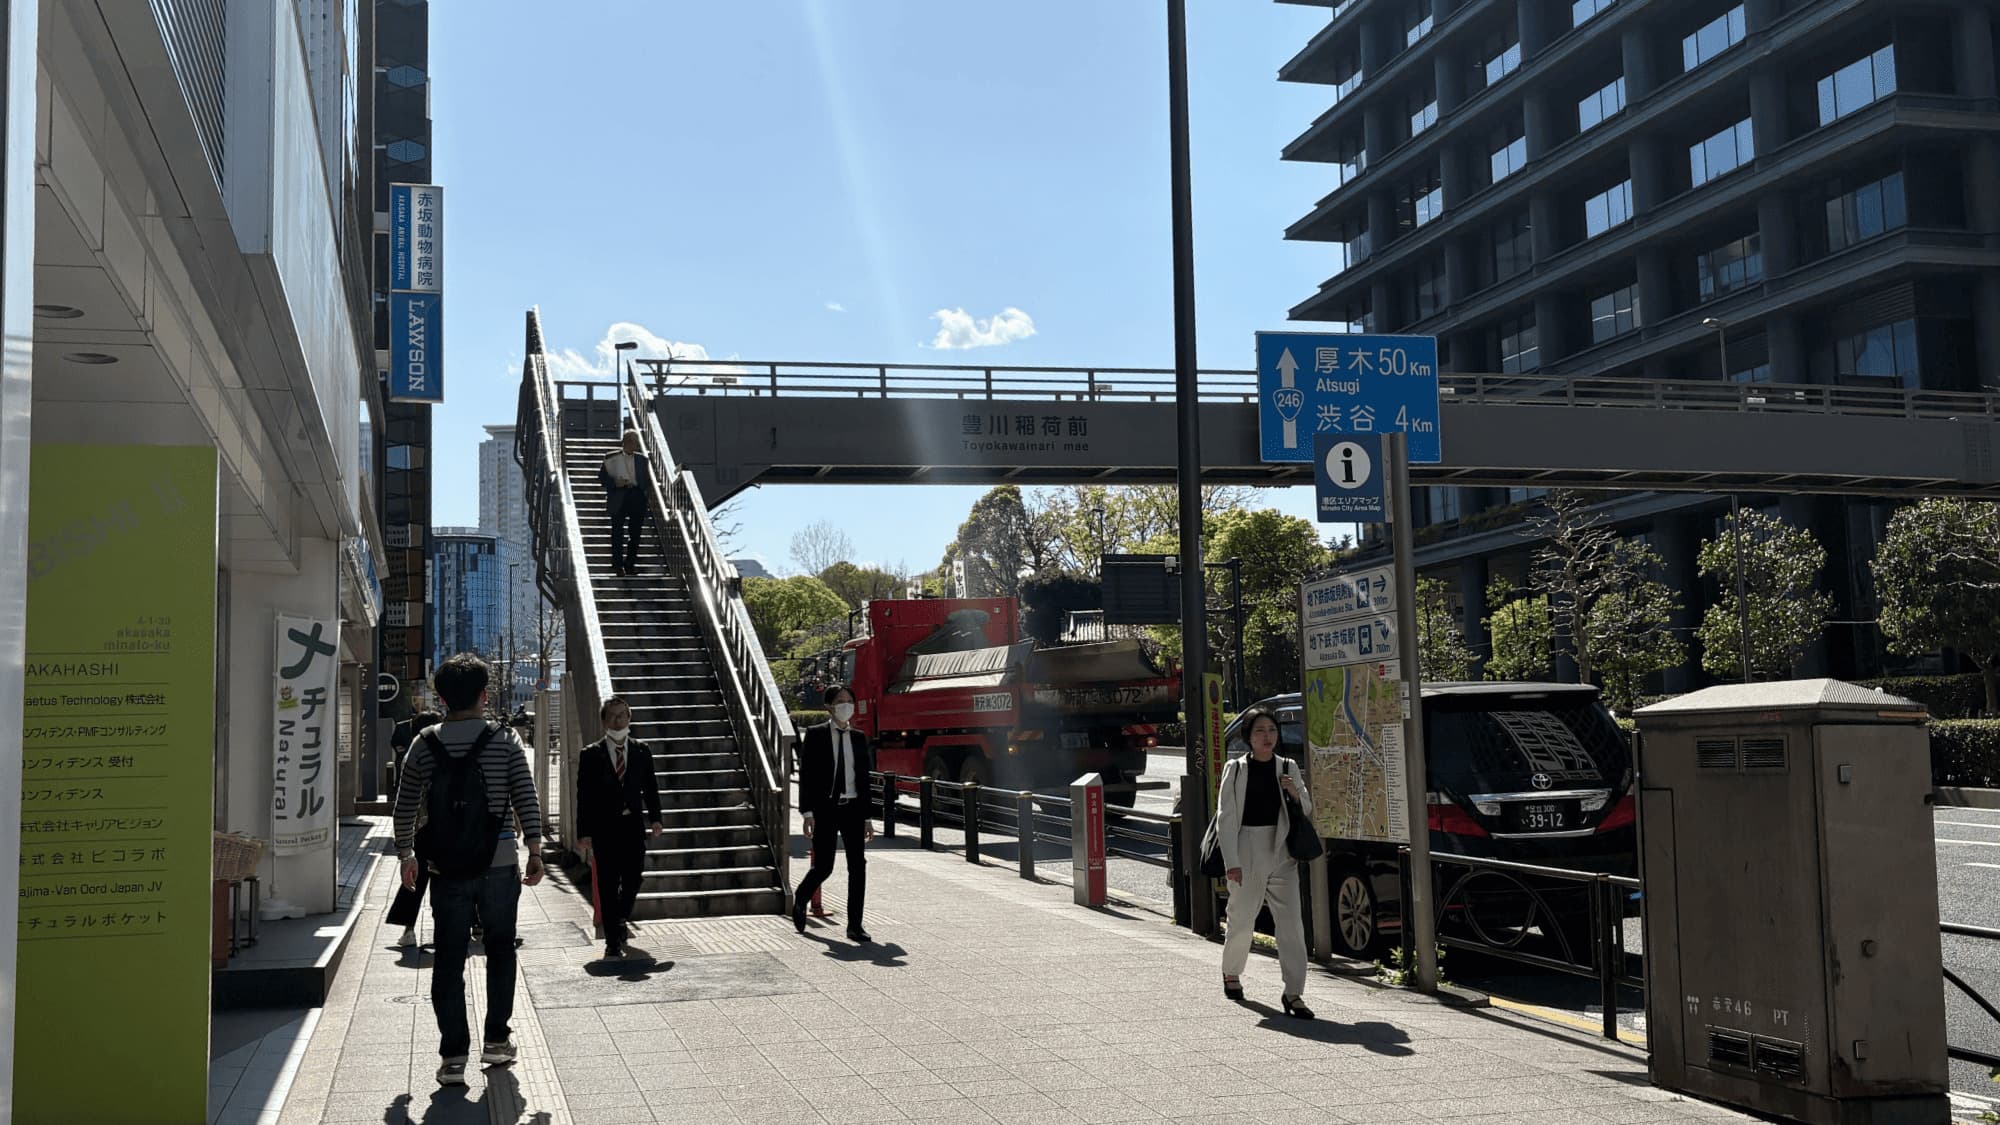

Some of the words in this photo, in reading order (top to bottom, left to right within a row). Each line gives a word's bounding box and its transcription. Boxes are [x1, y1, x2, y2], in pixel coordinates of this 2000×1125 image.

[416, 192, 433, 286] 赤坂動物病院
[408, 299, 424, 392] LAWSON
[1314, 346, 1374, 375] 厚木
[1378, 348, 1406, 376] 50
[1410, 362, 1431, 376] Km
[1315, 378, 1361, 395] Atsugi
[1277, 393, 1300, 408] 246
[961, 413, 1089, 437] 豊川稲荷前
[1316, 404, 1376, 432] 渋谷
[1395, 404, 1409, 433] 4
[1412, 418, 1433, 433] Km
[961, 440, 1055, 454] Toyokawainari
[1064, 442, 1089, 451] mae
[104, 639, 170, 650] minato-ku
[1309, 627, 1356, 650] 地下鉄赤坂駅
[26, 663, 119, 677] AKAHASHI
[26, 695, 58, 707] aetus
[61, 694, 123, 708] Technology
[125, 693, 167, 706] 株式会社
[22, 756, 104, 770] ンフィデンス
[108, 755, 134, 768] 受付
[273, 719, 297, 821] Natural
[21, 787, 104, 801] ンフィデンス
[1529, 812, 1564, 828] 39-12
[80, 883, 107, 895] Oord
[110, 882, 144, 896] Japan
[147, 880, 163, 893] JV
[17, 910, 167, 929] チュラルポケット
[1773, 1008, 1790, 1026] PT
